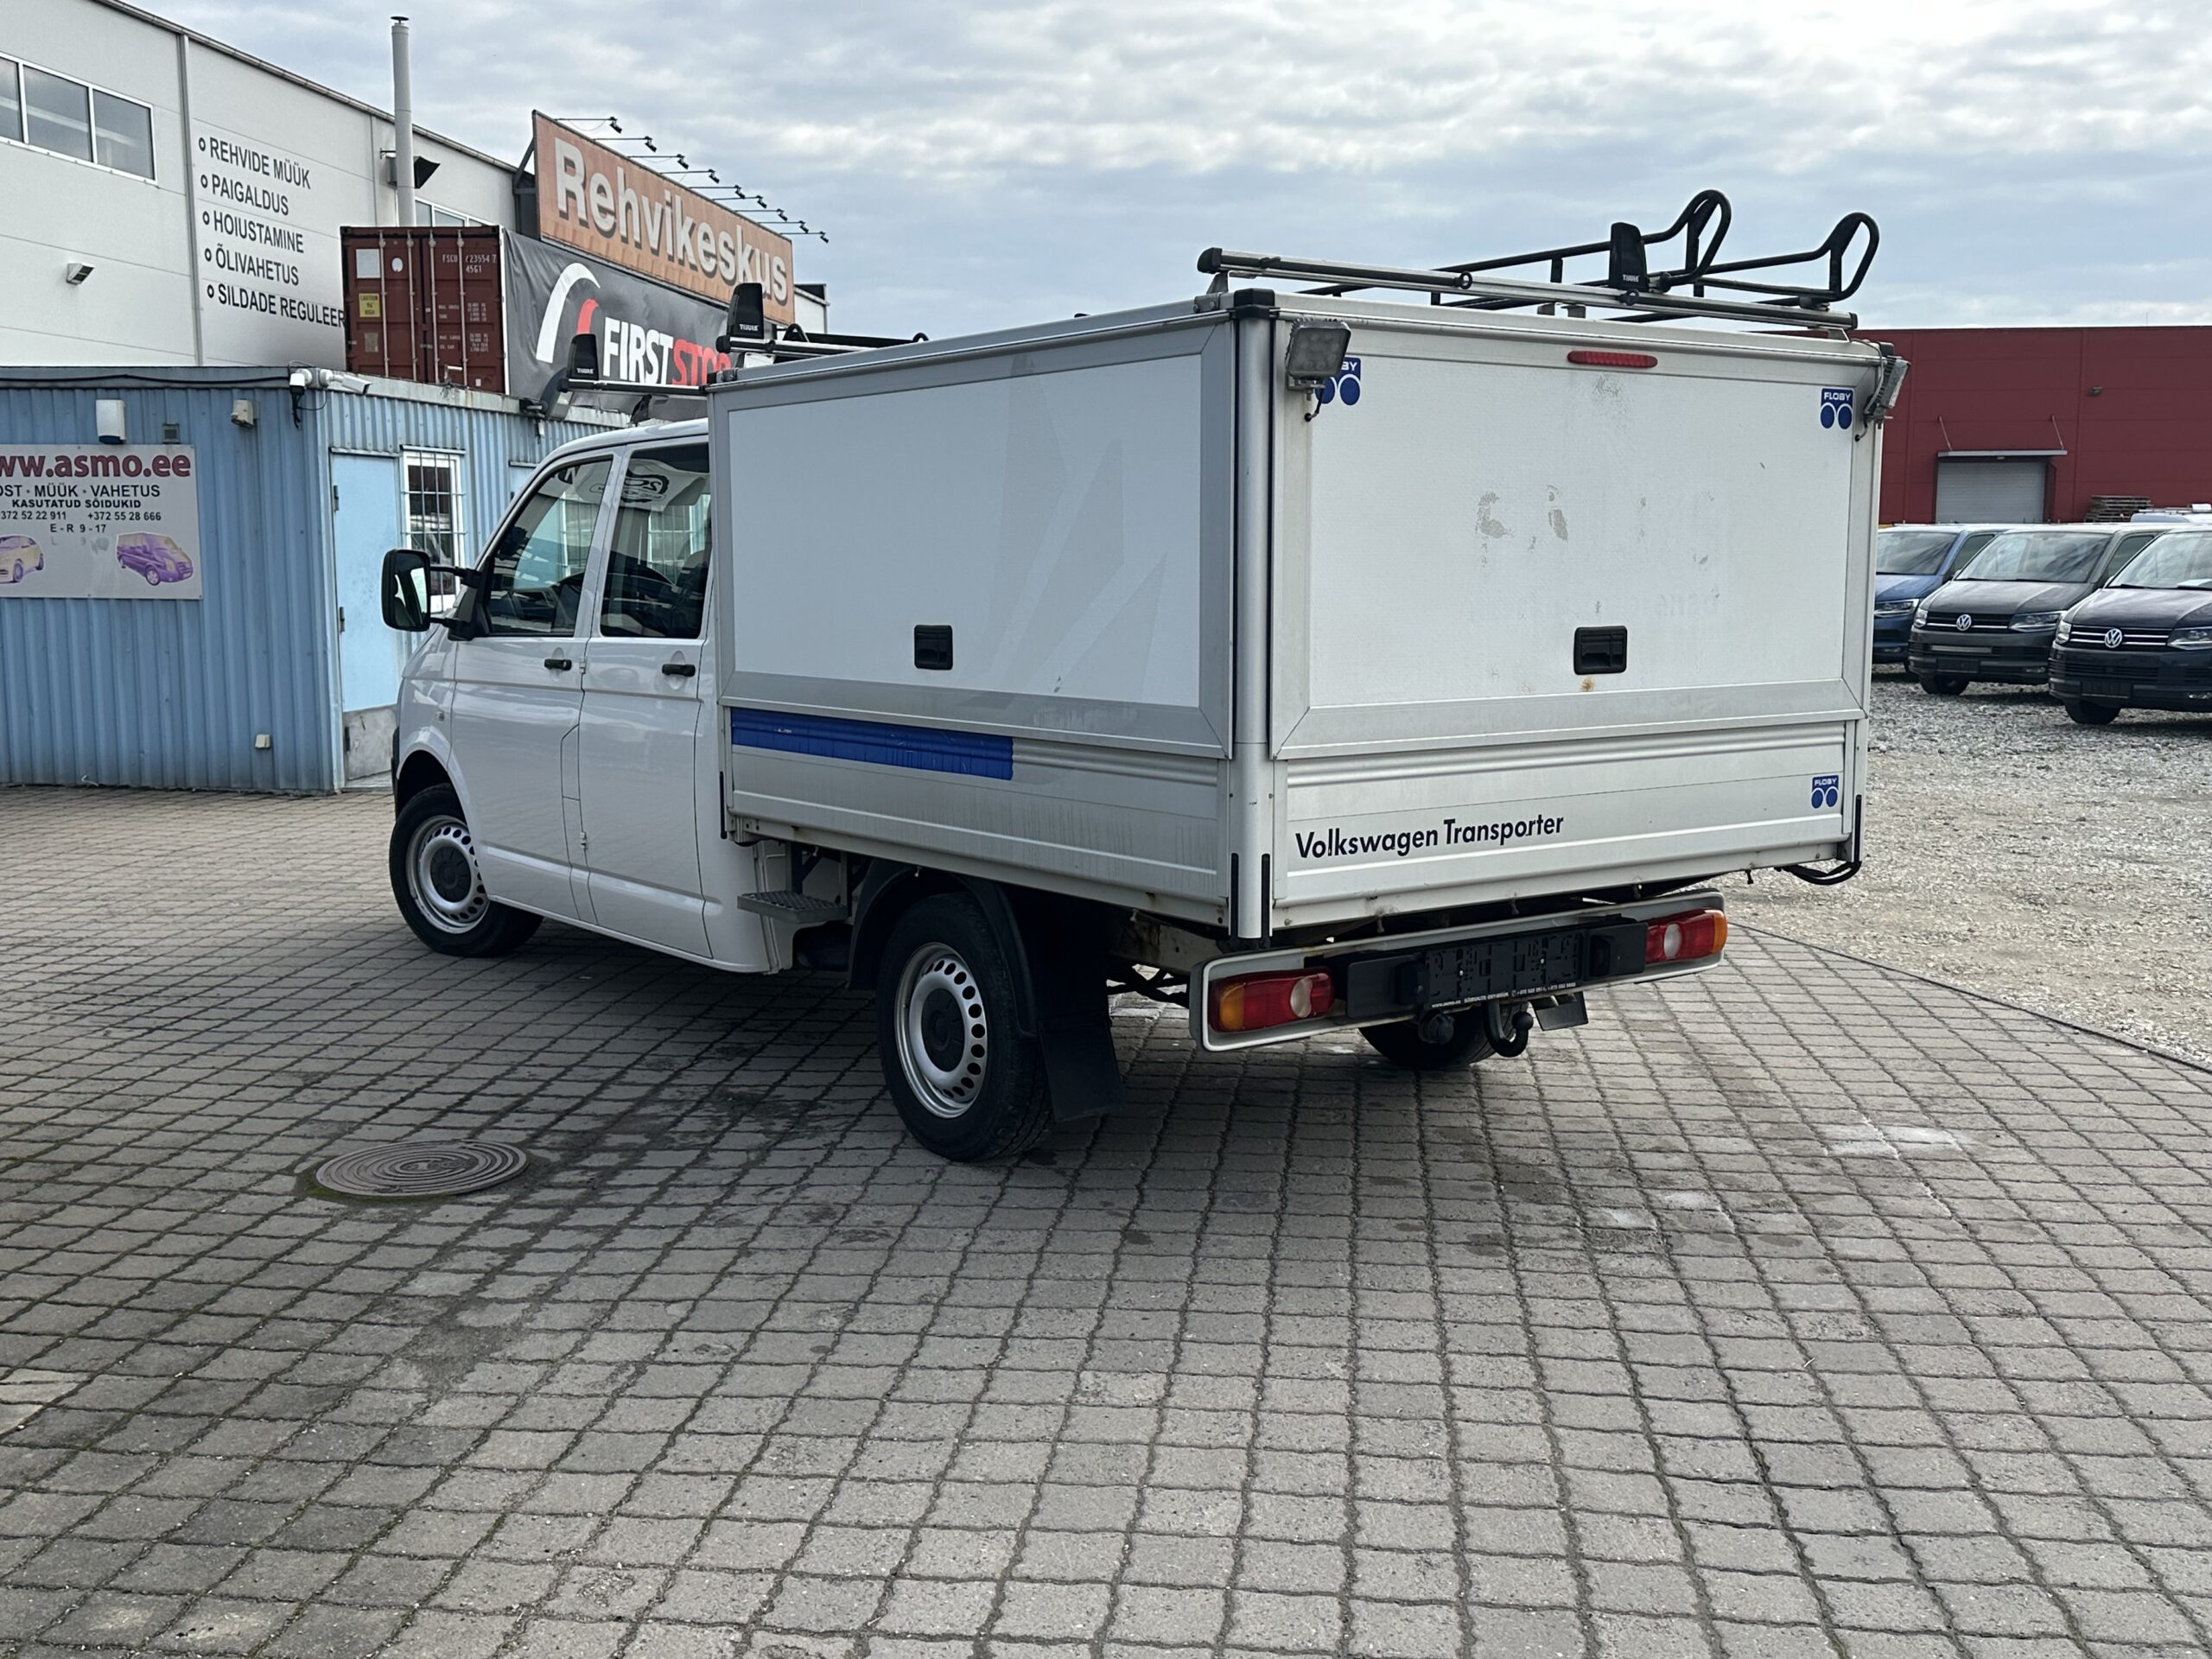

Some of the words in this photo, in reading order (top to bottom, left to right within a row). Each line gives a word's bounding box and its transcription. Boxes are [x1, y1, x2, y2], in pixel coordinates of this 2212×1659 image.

[209, 137, 270, 176] REHVIDE
[273, 158, 311, 190] MÜÜK
[212, 174, 289, 216] PAIGALDUS
[213, 210, 304, 254] HOIUSTAMINE
[554, 137, 788, 304] Rehvikeskus
[215, 243, 299, 286] ÕLIVAHETUS
[218, 283, 276, 315] SILDADE
[1823, 392, 1851, 401] FLOBY
[35, 482, 79, 498] MÜÜK
[90, 484, 161, 498] VAHETUS
[12, 499, 81, 508] KASUTATUD
[85, 497, 142, 508] SÕIDUKID
[21, 511, 33, 519] 52
[35, 511, 48, 520] 22
[50, 511, 67, 520] 911
[88, 512, 111, 520] +372
[114, 512, 126, 520] 55
[129, 512, 141, 521] 28
[143, 512, 162, 521] 666
[79, 524, 86, 532] 9
[95, 524, 106, 533] 17
[1815, 778, 1837, 786] FLOBY
[1295, 828, 1439, 858] Volkswagen
[1443, 814, 1564, 845] Transporter
